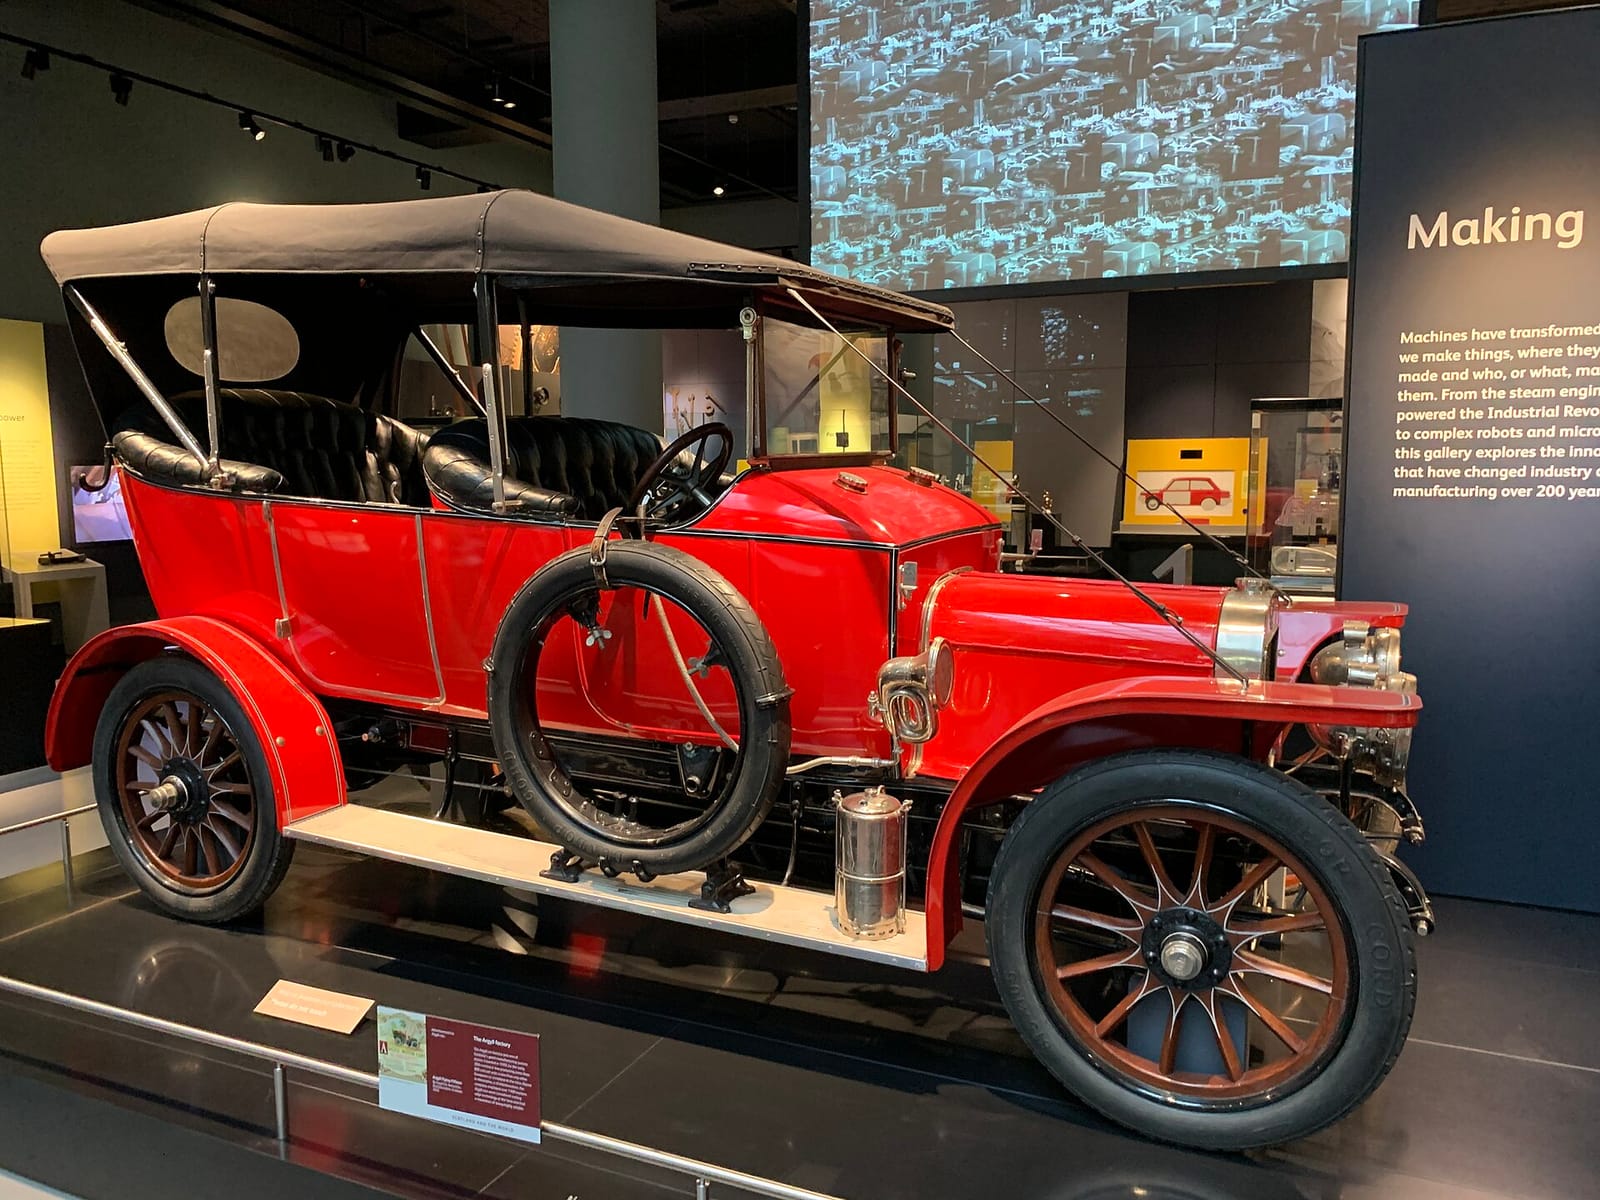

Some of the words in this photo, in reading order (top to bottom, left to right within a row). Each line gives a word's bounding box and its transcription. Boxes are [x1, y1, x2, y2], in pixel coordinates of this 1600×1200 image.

[1407, 206, 1584, 249] Making
[1400, 330, 1467, 344] Machines
[1472, 329, 1506, 341] have
[1510, 324, 1600, 339] transformed
[1399, 353, 1418, 363] we
[1422, 350, 1461, 362] make
[1465, 348, 1514, 362] things,
[1517, 346, 1563, 358] where
[1398, 370, 1438, 382] made
[1441, 369, 1469, 381] and
[1473, 367, 1507, 381] who,
[1511, 369, 1526, 378] or
[1530, 366, 1571, 378] what,
[1398, 390, 1437, 402] them.
[1442, 388, 1477, 400] From
[1481, 387, 1506, 400] the
[1509, 387, 1555, 398] steam
[1397, 408, 1455, 423] powered
[1460, 407, 1483, 419] the
[1488, 405, 1559, 419] Industrial
[1396, 429, 1410, 440] to
[1414, 427, 1473, 442] complex
[1477, 426, 1523, 438] robots
[1527, 425, 1555, 438] and
[1395, 447, 1420, 459] this
[1424, 447, 1472, 461] gallery
[1476, 446, 1536, 461] explores
[1540, 446, 1565, 457] the
[1394, 467, 1423, 478] that
[1427, 466, 1460, 478] have
[1464, 466, 1526, 480] changed
[1531, 466, 1592, 480] industry
[1393, 485, 1497, 500] manufacturing
[1501, 487, 1533, 497] over
[1536, 485, 1565, 497] 200
[473, 1035, 482, 1043] The
